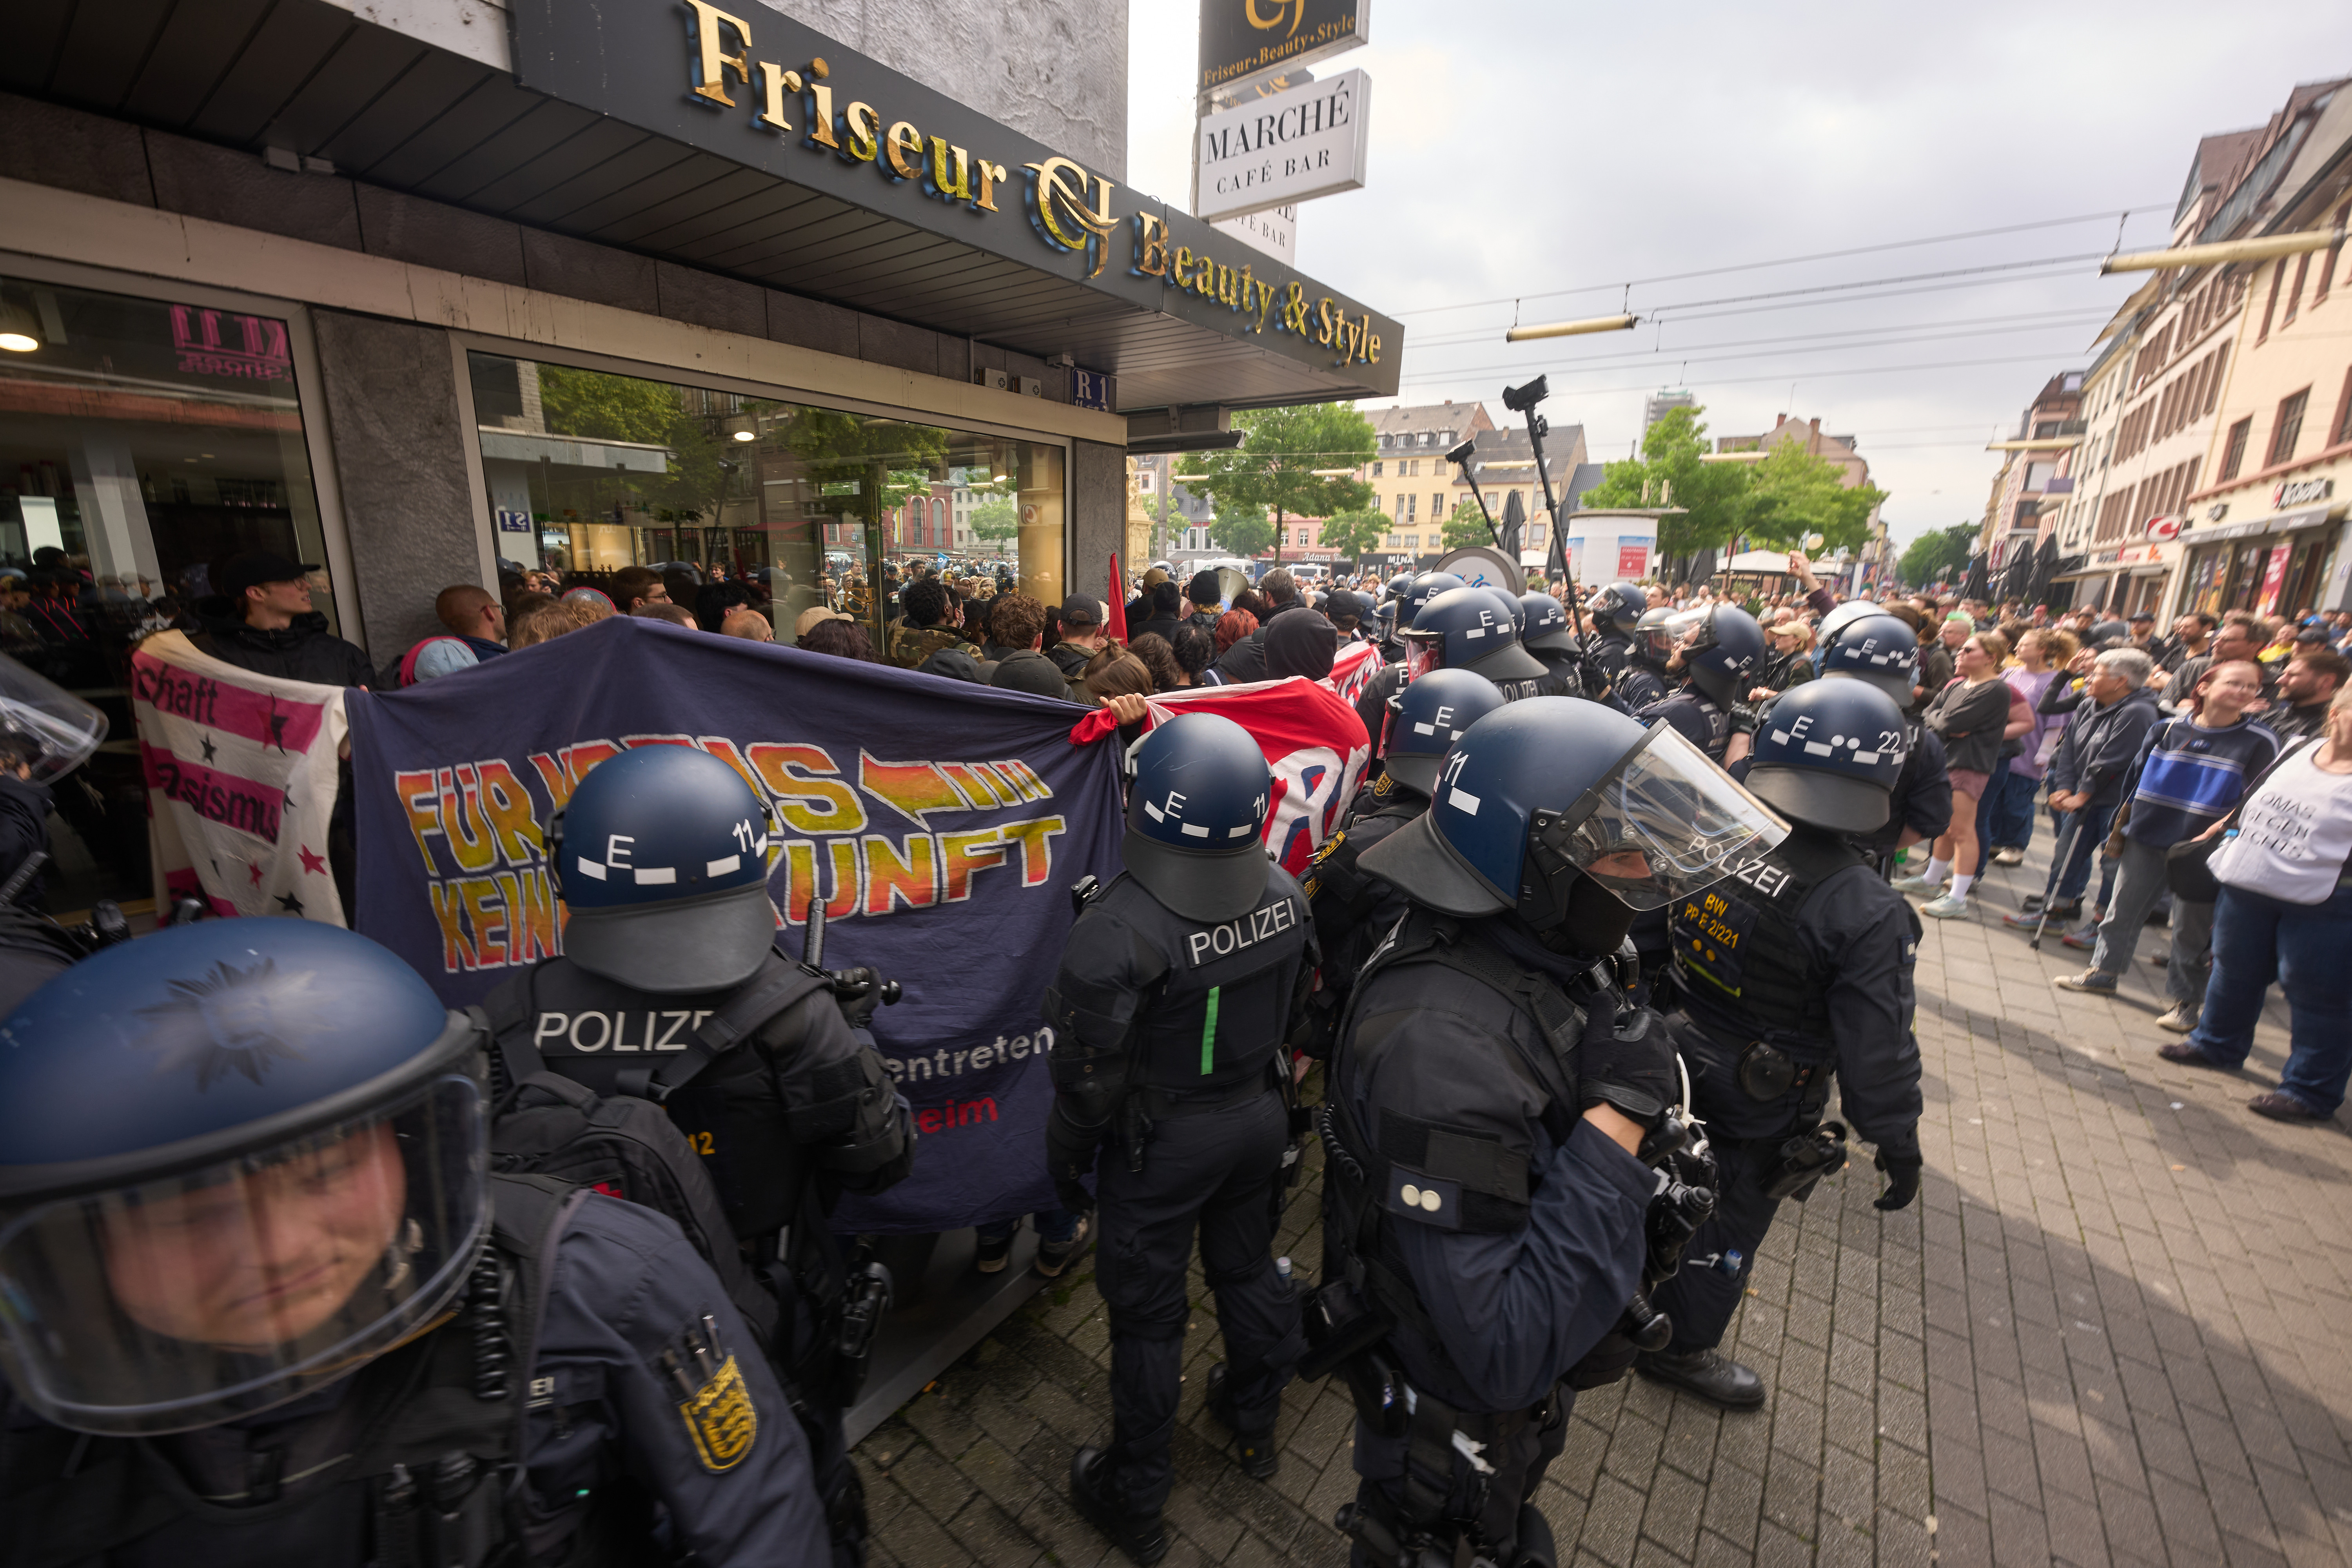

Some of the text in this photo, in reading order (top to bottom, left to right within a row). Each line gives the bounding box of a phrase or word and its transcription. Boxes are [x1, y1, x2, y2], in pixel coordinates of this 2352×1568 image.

[1203, 56, 1251, 87] Friseur
[1259, 34, 1309, 65] Beauty
[1317, 13, 1356, 43] Style
[1205, 79, 1349, 165] MARCHÉ
[683, 0, 1007, 213] Friseur
[1135, 211, 1275, 334] Beauty
[1282, 281, 1309, 336] &
[1316, 297, 1381, 368] Style
[1217, 148, 1330, 194] CAFÉ BAR
[1263, 221, 1286, 248] BAR
[1076, 370, 1107, 404] R 1
[1302, 552, 1331, 562] Adana
[1426, 587, 1439, 600] E
[1548, 608, 1557, 619] E
[1479, 610, 1494, 627] E
[1738, 655, 1753, 670] E
[1861, 638, 1878, 655] E
[1434, 706, 1454, 728] E
[1789, 715, 1814, 739] E
[1876, 731, 1901, 754] 22
[1444, 751, 1469, 787] 11
[157, 764, 279, 845] asismus
[394, 758, 548, 878] FÜR
[1164, 790, 1266, 819] E 11
[607, 818, 756, 869] E 11
[1687, 833, 1791, 898] POLIZEI
[428, 865, 566, 973] KEIN
[1684, 902, 1740, 949] PP E 2/221
[1704, 893, 1729, 918] BW
[1189, 898, 1296, 964] POLIZEI
[534, 1010, 715, 1053] POLIZ
[886, 1026, 1055, 1083] entreten
